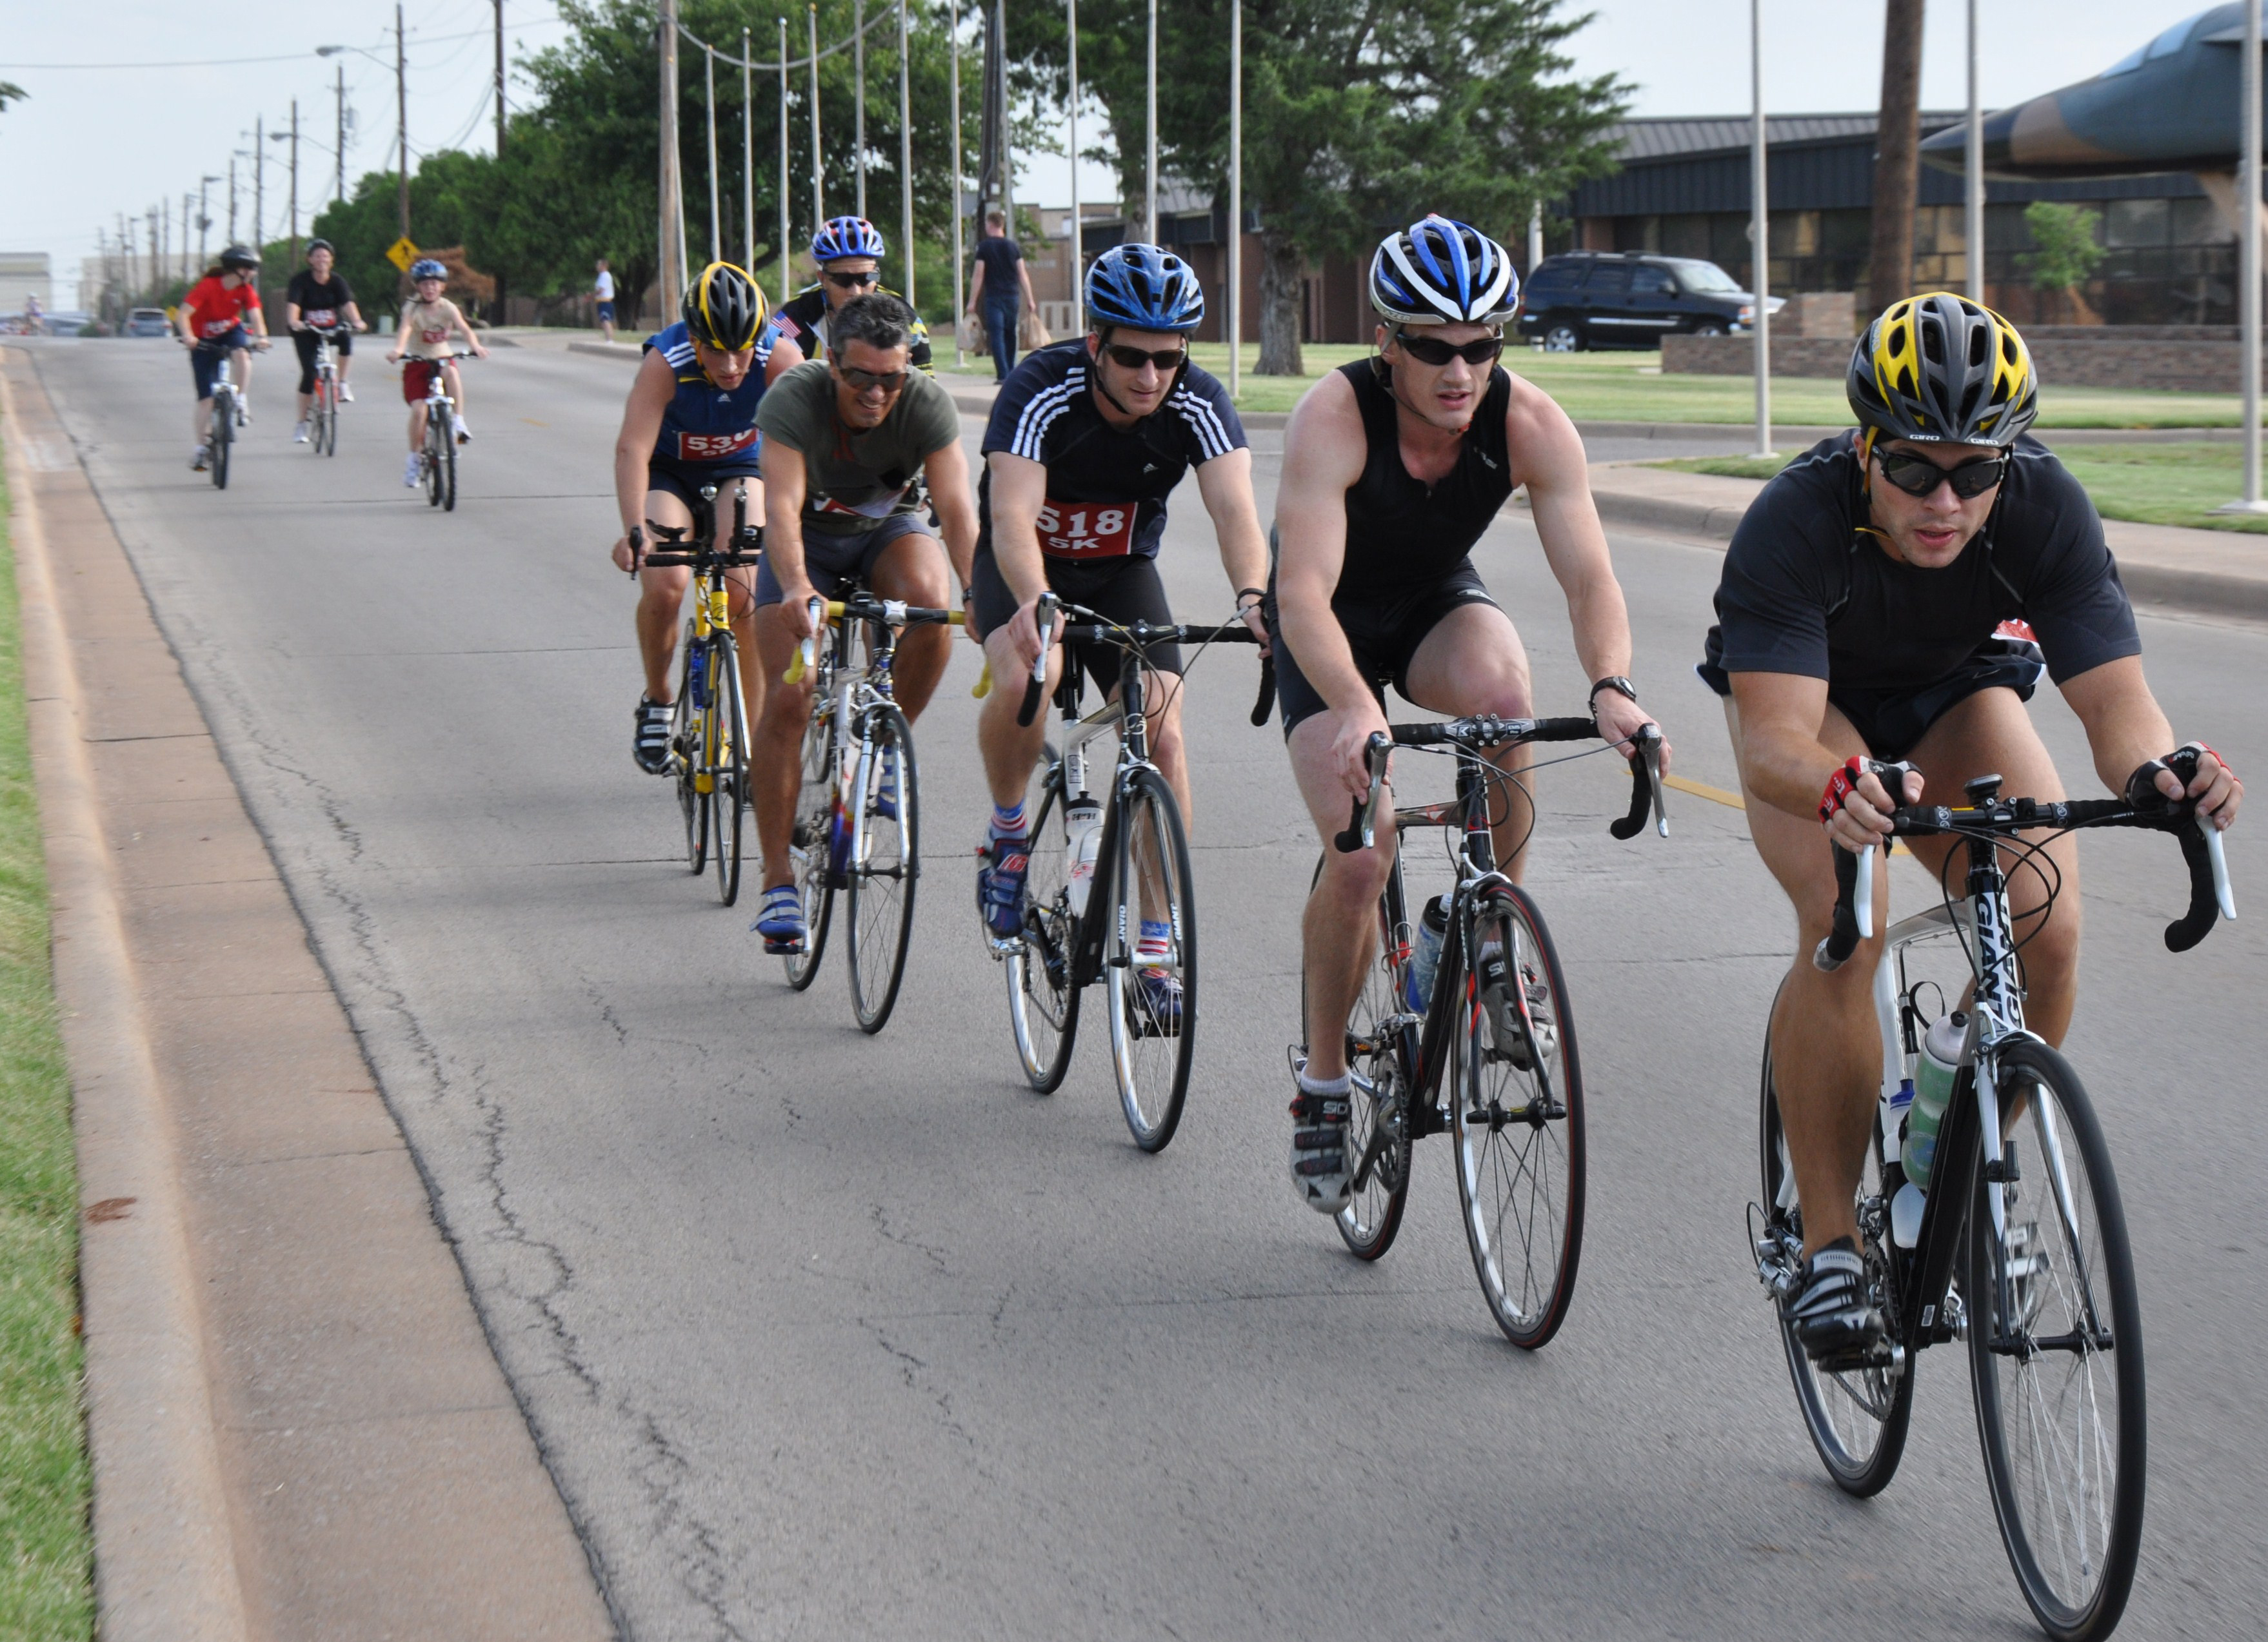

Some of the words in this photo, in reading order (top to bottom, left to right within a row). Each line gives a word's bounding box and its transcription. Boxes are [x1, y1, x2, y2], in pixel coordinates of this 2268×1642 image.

[1380, 308, 1411, 321] LAZER
[1035, 505, 1125, 538] 518
[1048, 537, 1100, 550] 5K
[1118, 904, 1126, 943] GIANT
[1170, 902, 1182, 941] GIANT
[1975, 893, 2004, 1022] GIANT
